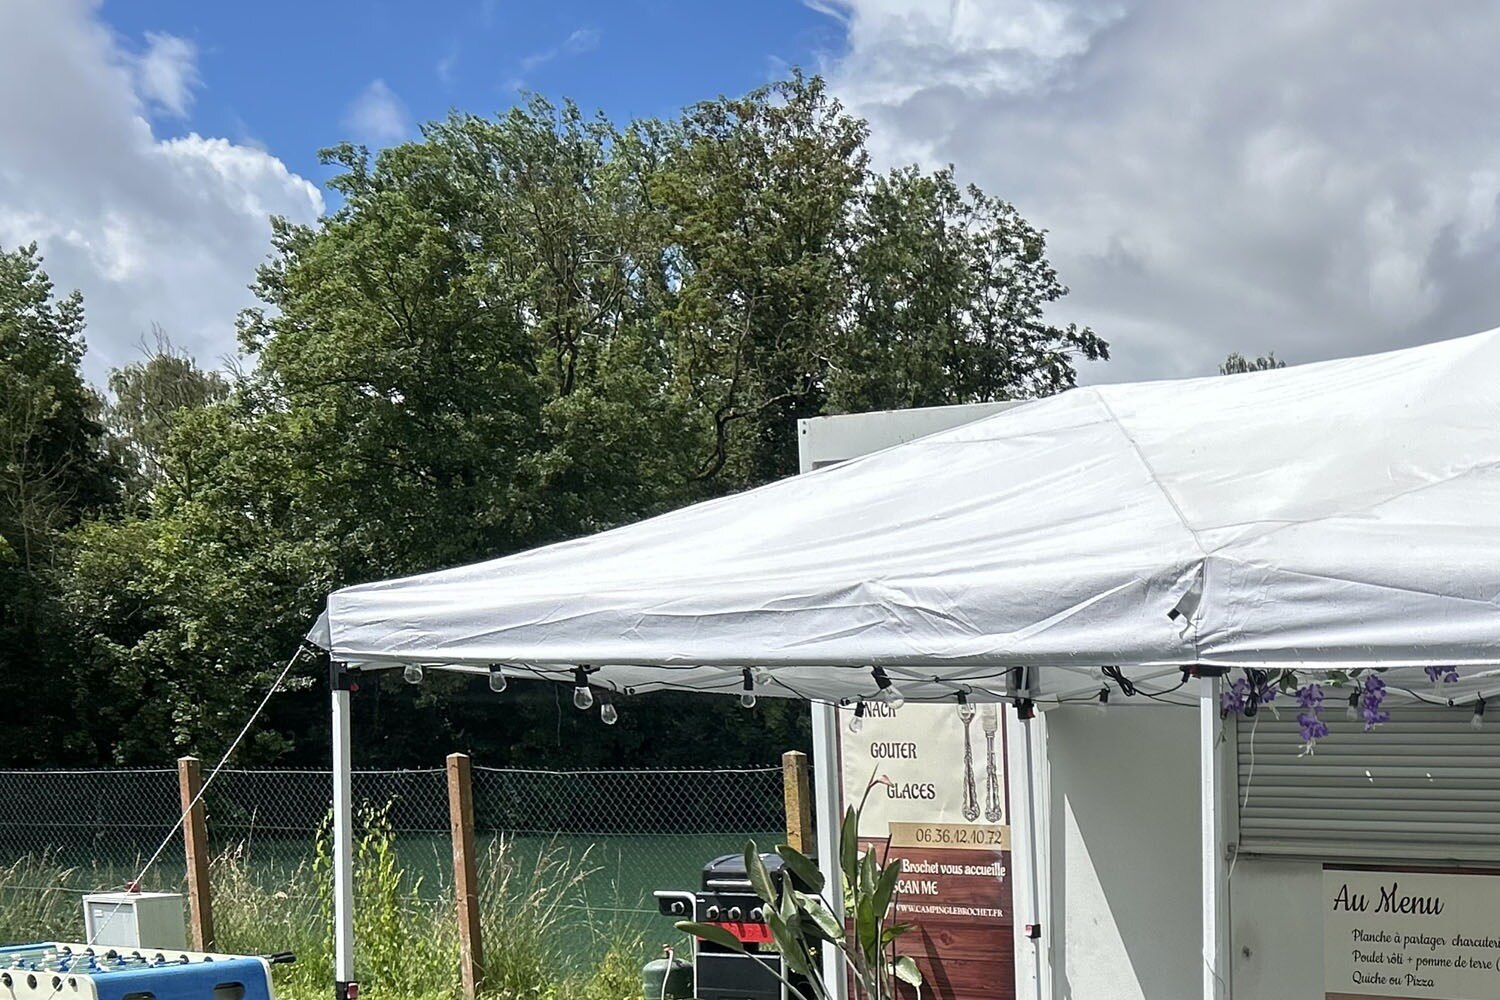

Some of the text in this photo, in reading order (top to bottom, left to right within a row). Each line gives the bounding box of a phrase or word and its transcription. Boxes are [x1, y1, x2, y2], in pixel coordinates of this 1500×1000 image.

[862, 701, 896, 718] NACK
[870, 742, 917, 760] GOUTER
[887, 783, 935, 800] GLACES
[916, 828, 1002, 845] 06.36.12.10.72
[902, 858, 938, 874] Brochet
[940, 866, 963, 875] vous
[964, 862, 1006, 877] accueille
[922, 881, 938, 895] ME
[1333, 882, 1444, 915] Au Menu
[1351, 928, 1392, 943] Planche
[1394, 932, 1401, 943] à
[1403, 934, 1446, 951] partager
[1351, 949, 1384, 964] Poulet
[1386, 952, 1403, 965] rôti
[1416, 957, 1452, 971] pomme
[1454, 955, 1467, 968] de
[1469, 957, 1493, 969] terre
[1352, 970, 1434, 987] Quiche ou Pizza
